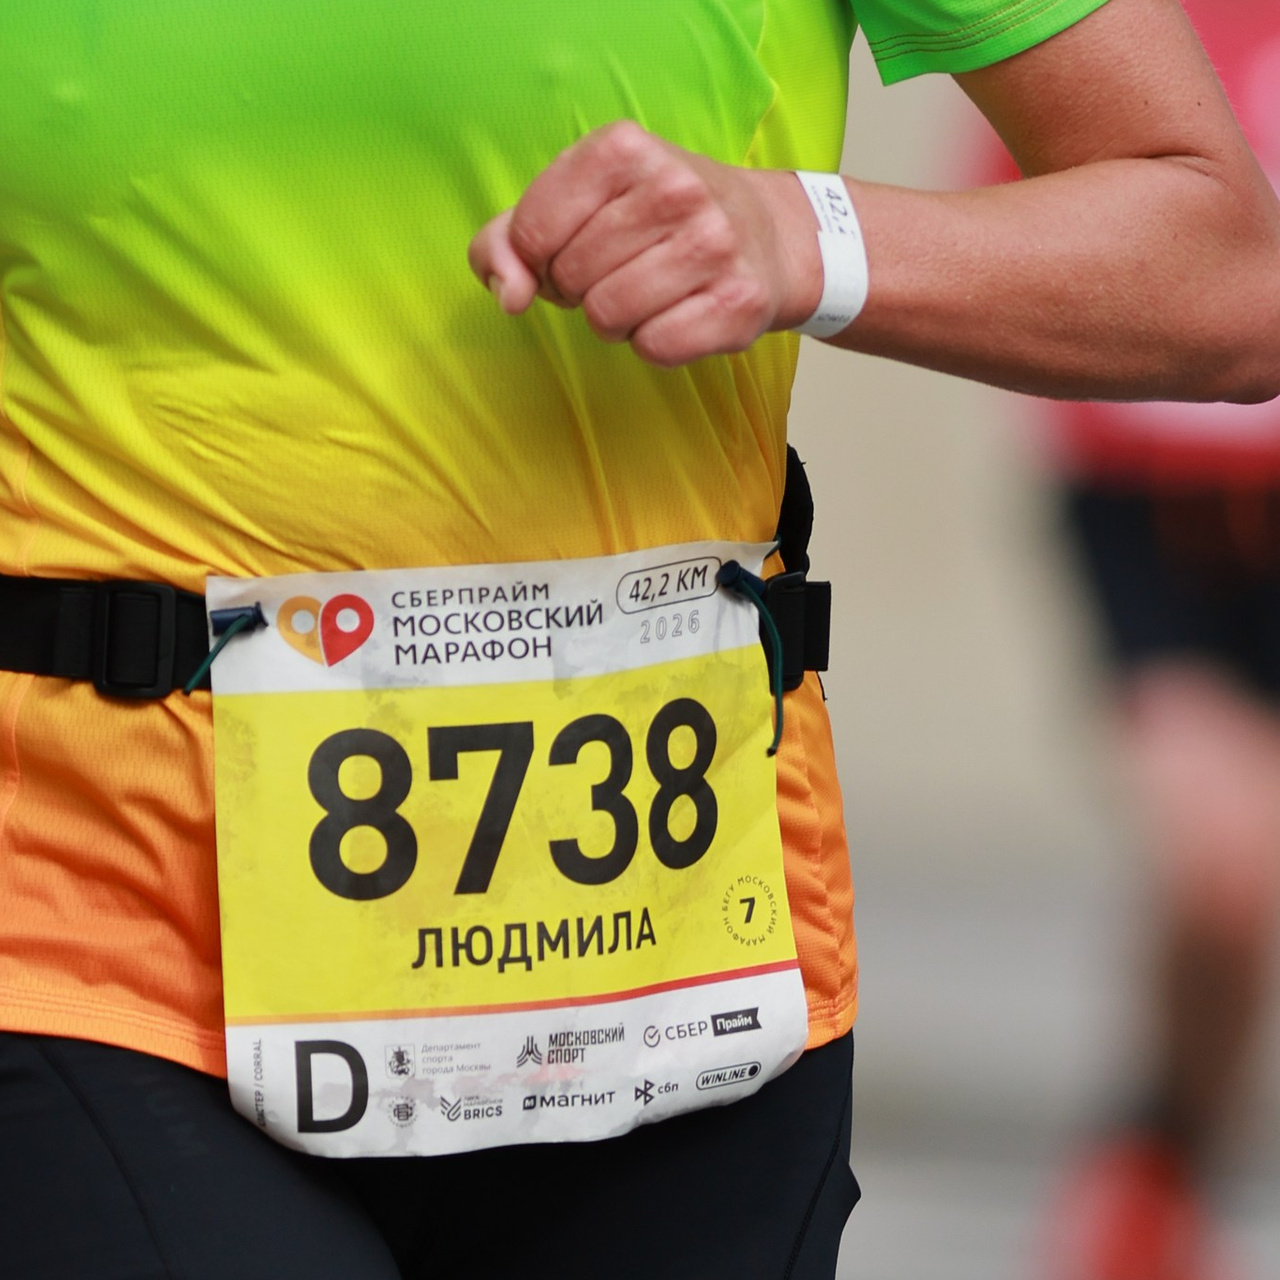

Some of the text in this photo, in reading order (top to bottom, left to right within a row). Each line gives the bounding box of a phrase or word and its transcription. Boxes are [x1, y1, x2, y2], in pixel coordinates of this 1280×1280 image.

[391, 581, 550, 608] СБЕРПРАЙМ
[629, 572, 670, 602] 42,2
[393, 598, 603, 637] МОСКОВСКИЙ
[640, 609, 700, 644] 2026
[395, 636, 552, 665] МАРАФОН
[308, 697, 718, 901] 8738
[739, 896, 756, 924] 7
[411, 907, 656, 973] ЛЮДМИЛА
[548, 1022, 625, 1048] МОСКОВСКИЙ
[665, 1014, 753, 1040] СБЕР Прайм
[253, 1038, 263, 1081] CORRAL
[421, 1042, 481, 1053] Департамент
[422, 1055, 453, 1064] спорта
[547, 1048, 586, 1065] СПОРТ
[295, 1039, 369, 1134] D
[658, 1082, 679, 1094] сбп
[701, 1068, 747, 1086] WINLINE
[464, 1105, 503, 1121] BRICS
